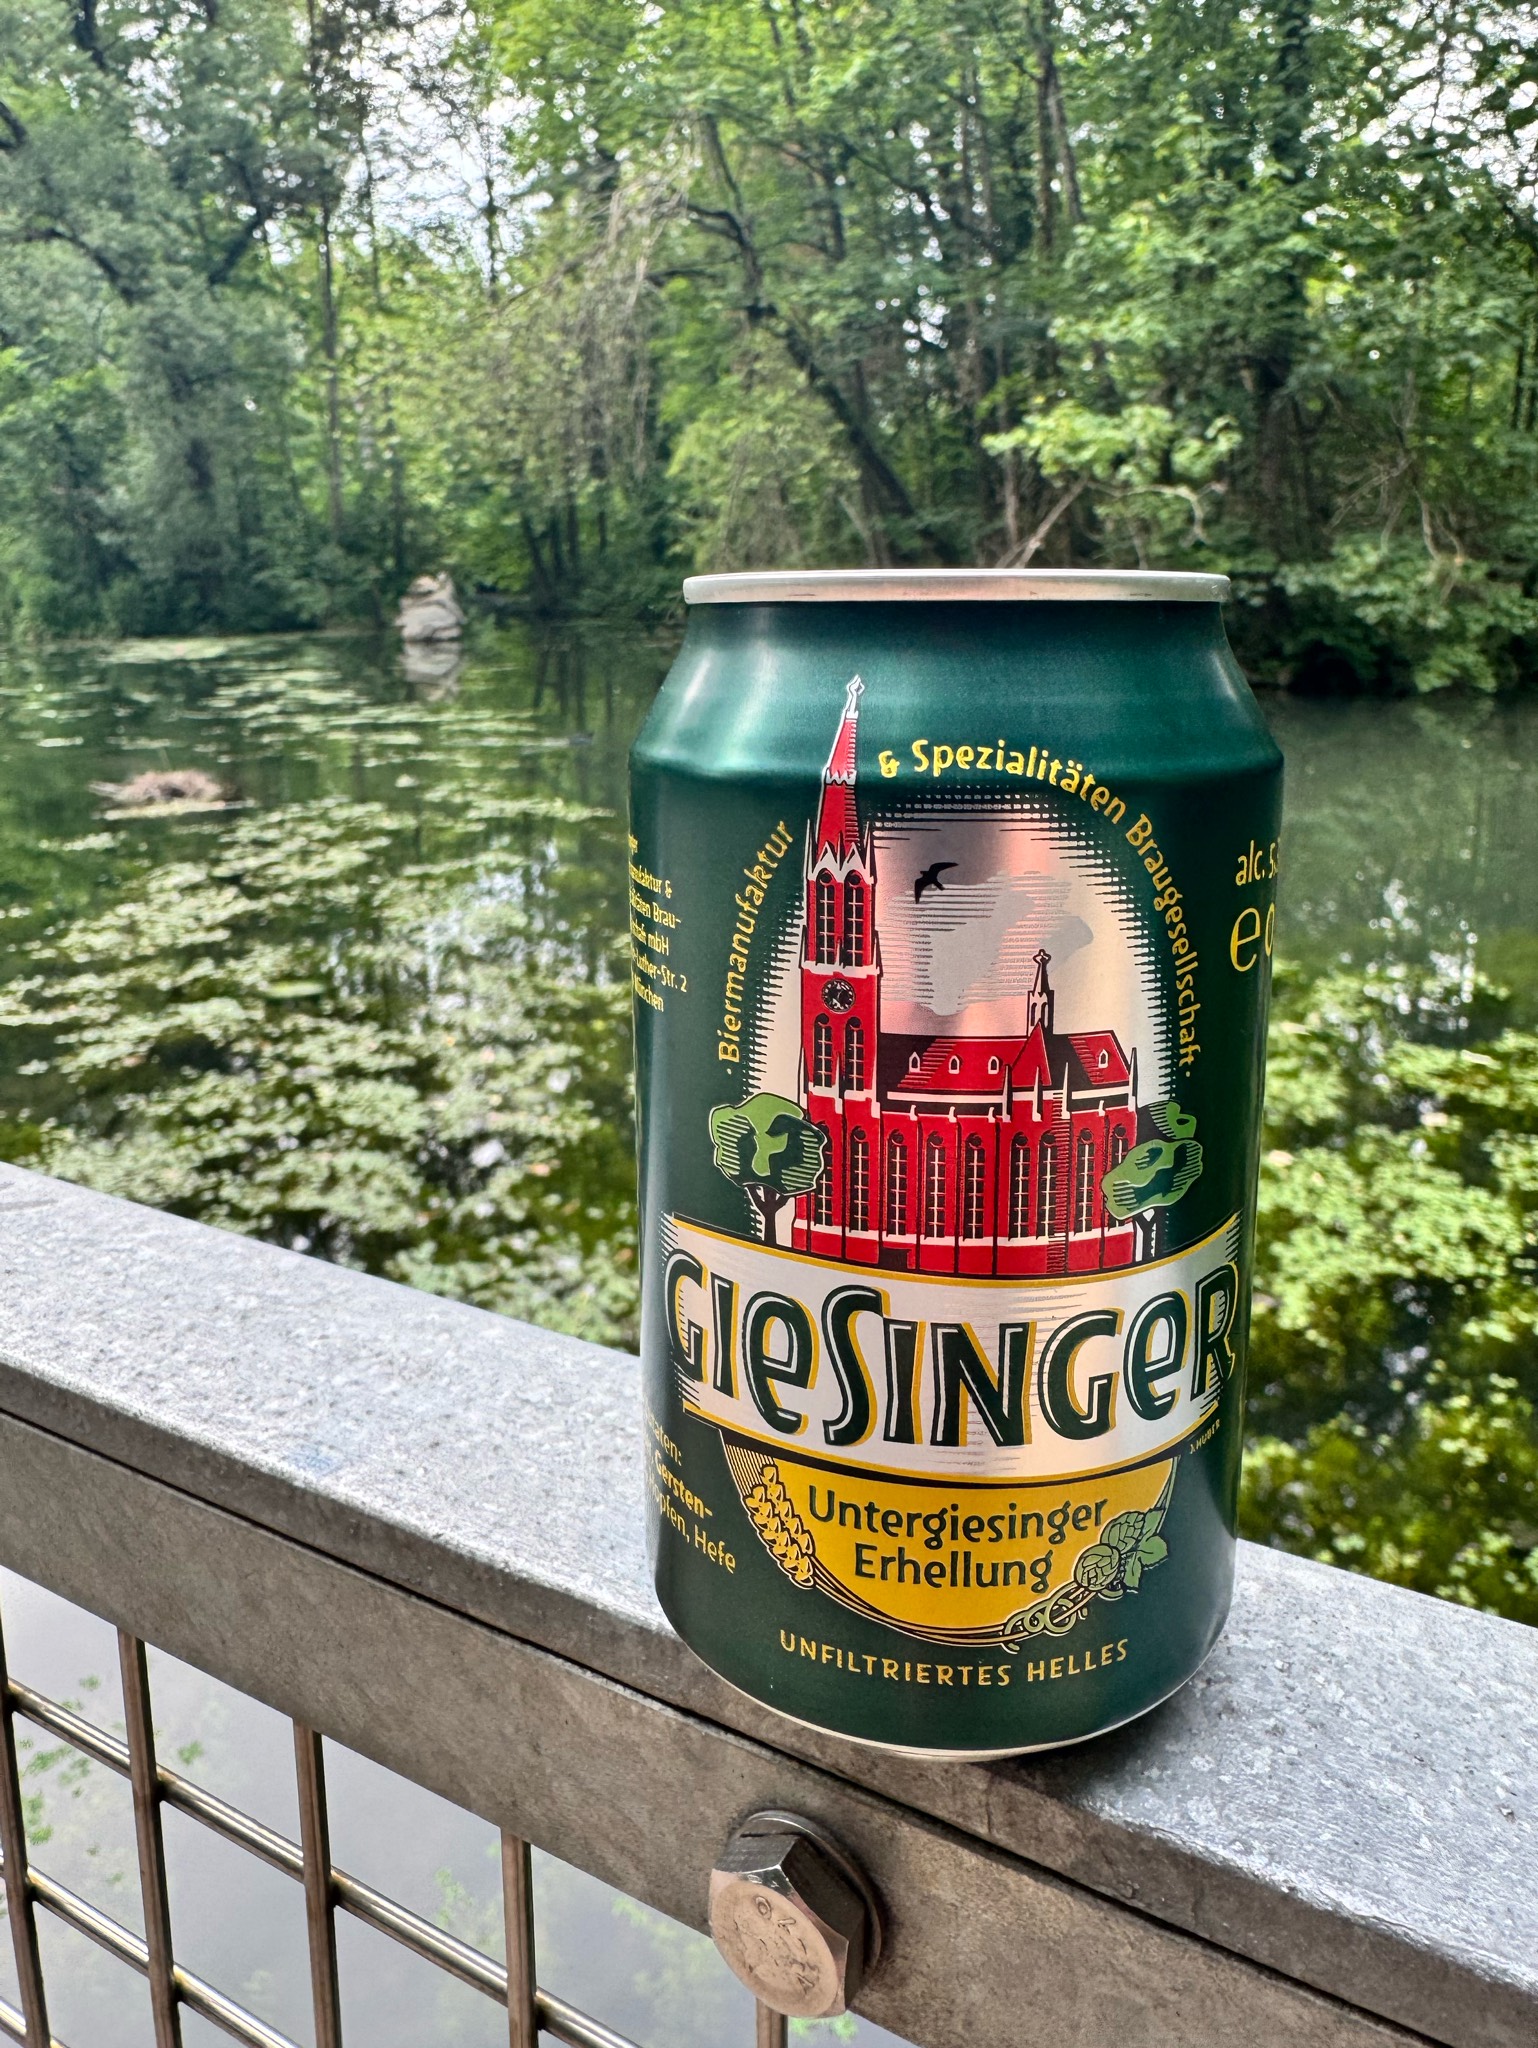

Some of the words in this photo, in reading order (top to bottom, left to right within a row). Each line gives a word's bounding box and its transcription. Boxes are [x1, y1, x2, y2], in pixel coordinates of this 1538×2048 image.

[1235, 839, 1265, 886] alc.
[652, 901, 681, 928] Brau-
[879, 750, 899, 778] &
[912, 739, 1127, 825] Spezialitäten
[1125, 812, 1202, 1068] Braugesellschaft
[647, 930, 669, 956] mbH
[717, 820, 795, 1064] Biermanufaktur
[680, 973, 687, 993] 2
[655, 1449, 713, 1519] Gersten-
[808, 1484, 1109, 1550] Untergiesinger
[694, 1524, 736, 1574] Hefe
[854, 1542, 1054, 1594] Erhellung
[779, 1628, 1011, 1687] UNFILTRIERTES
[1026, 1637, 1129, 1683] HELLES
